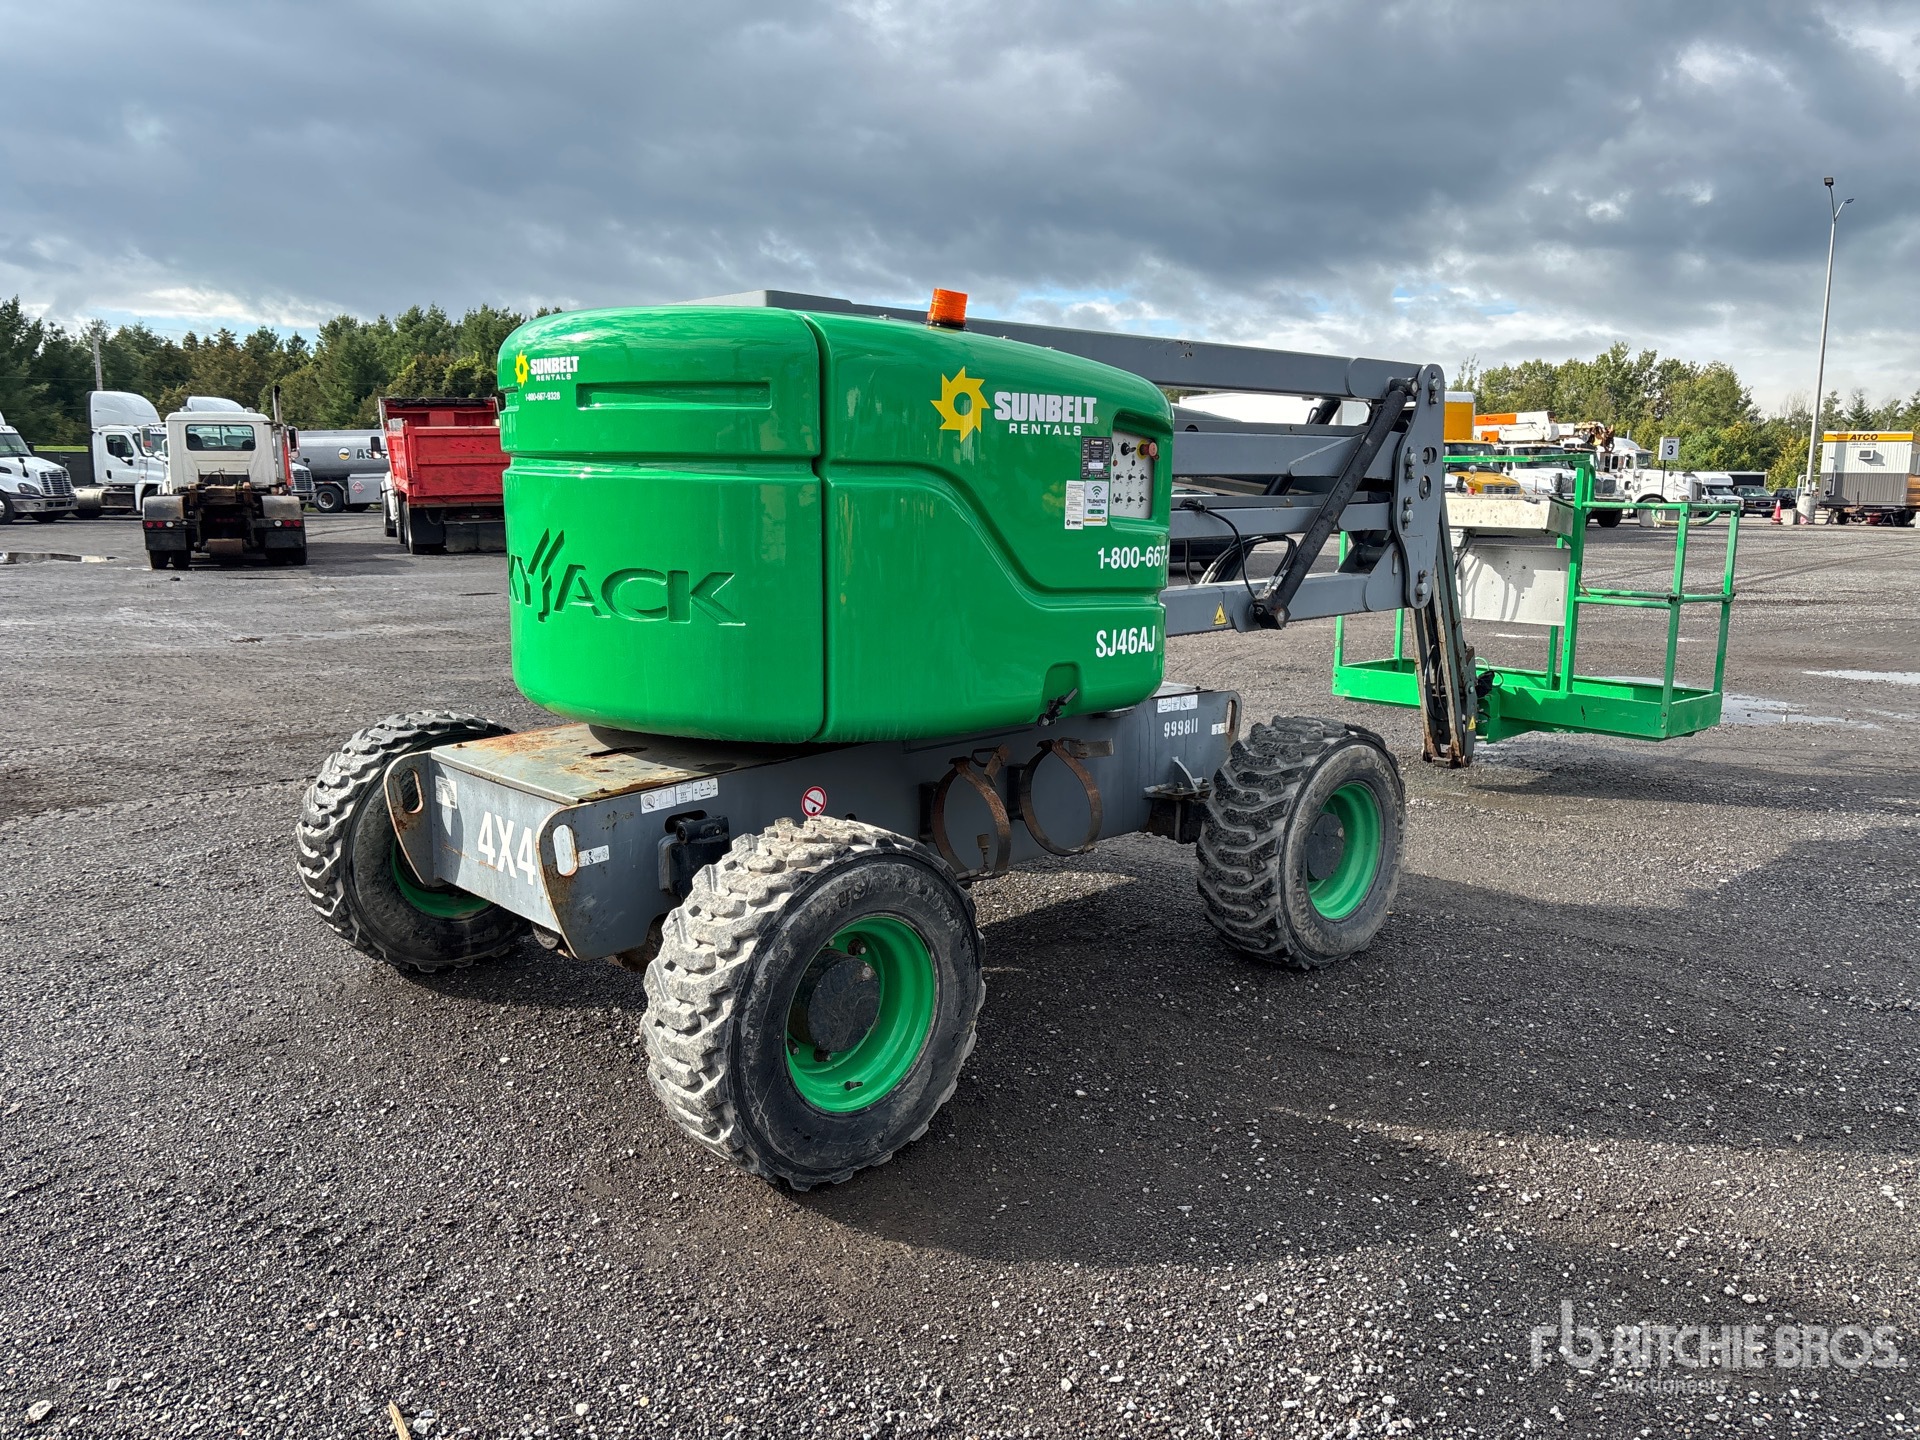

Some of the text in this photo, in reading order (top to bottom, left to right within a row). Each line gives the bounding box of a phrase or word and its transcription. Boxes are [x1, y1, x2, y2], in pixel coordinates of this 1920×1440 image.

[530, 356, 579, 375] SUNBELT
[535, 373, 572, 382] RENTALS
[994, 391, 1098, 424] SUNBELT
[1008, 423, 1082, 436] RENTALS
[1666, 445, 1674, 455] 3
[1095, 625, 1156, 658] SJ46AJ
[1163, 717, 1199, 739] 999811
[477, 811, 537, 886] 4X4
